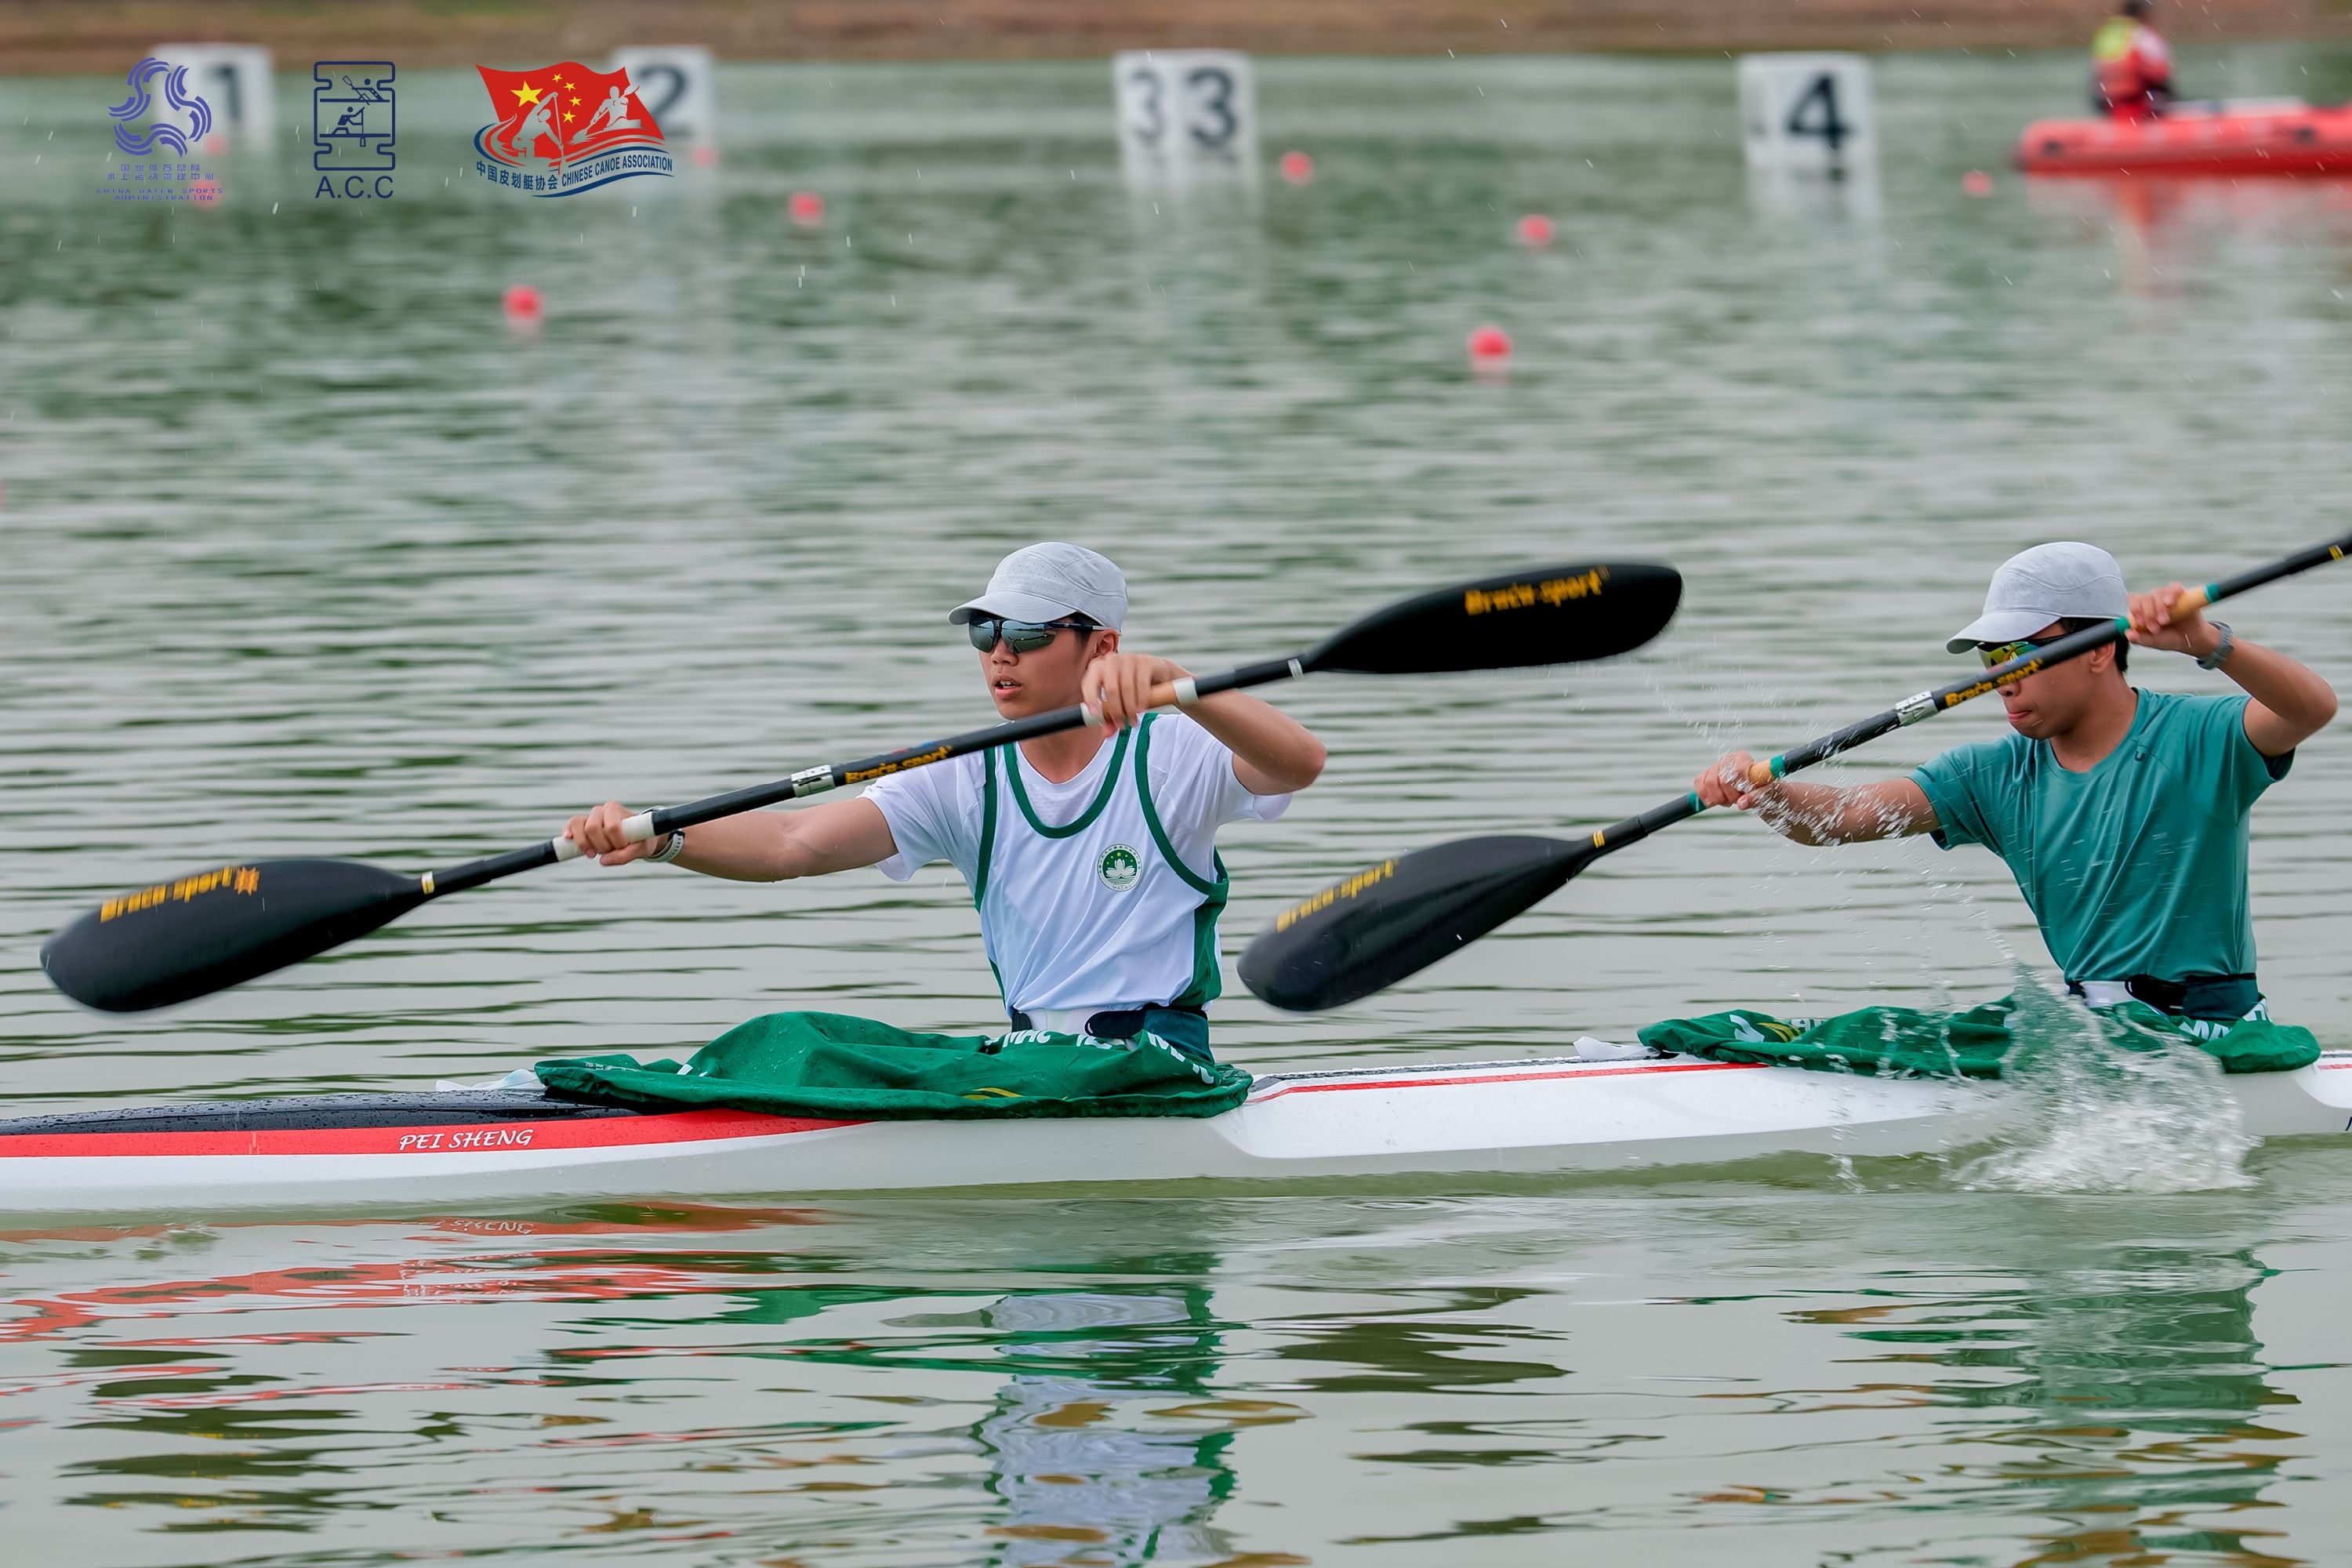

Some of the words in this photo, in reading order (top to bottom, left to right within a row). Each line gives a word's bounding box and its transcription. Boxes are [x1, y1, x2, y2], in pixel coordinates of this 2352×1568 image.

[205, 64, 243, 122] 1
[1185, 65, 1239, 150] 3
[1784, 75, 1852, 152] 4
[399, 1134, 445, 1151] PEI
[448, 1129, 534, 1149] SHENG
